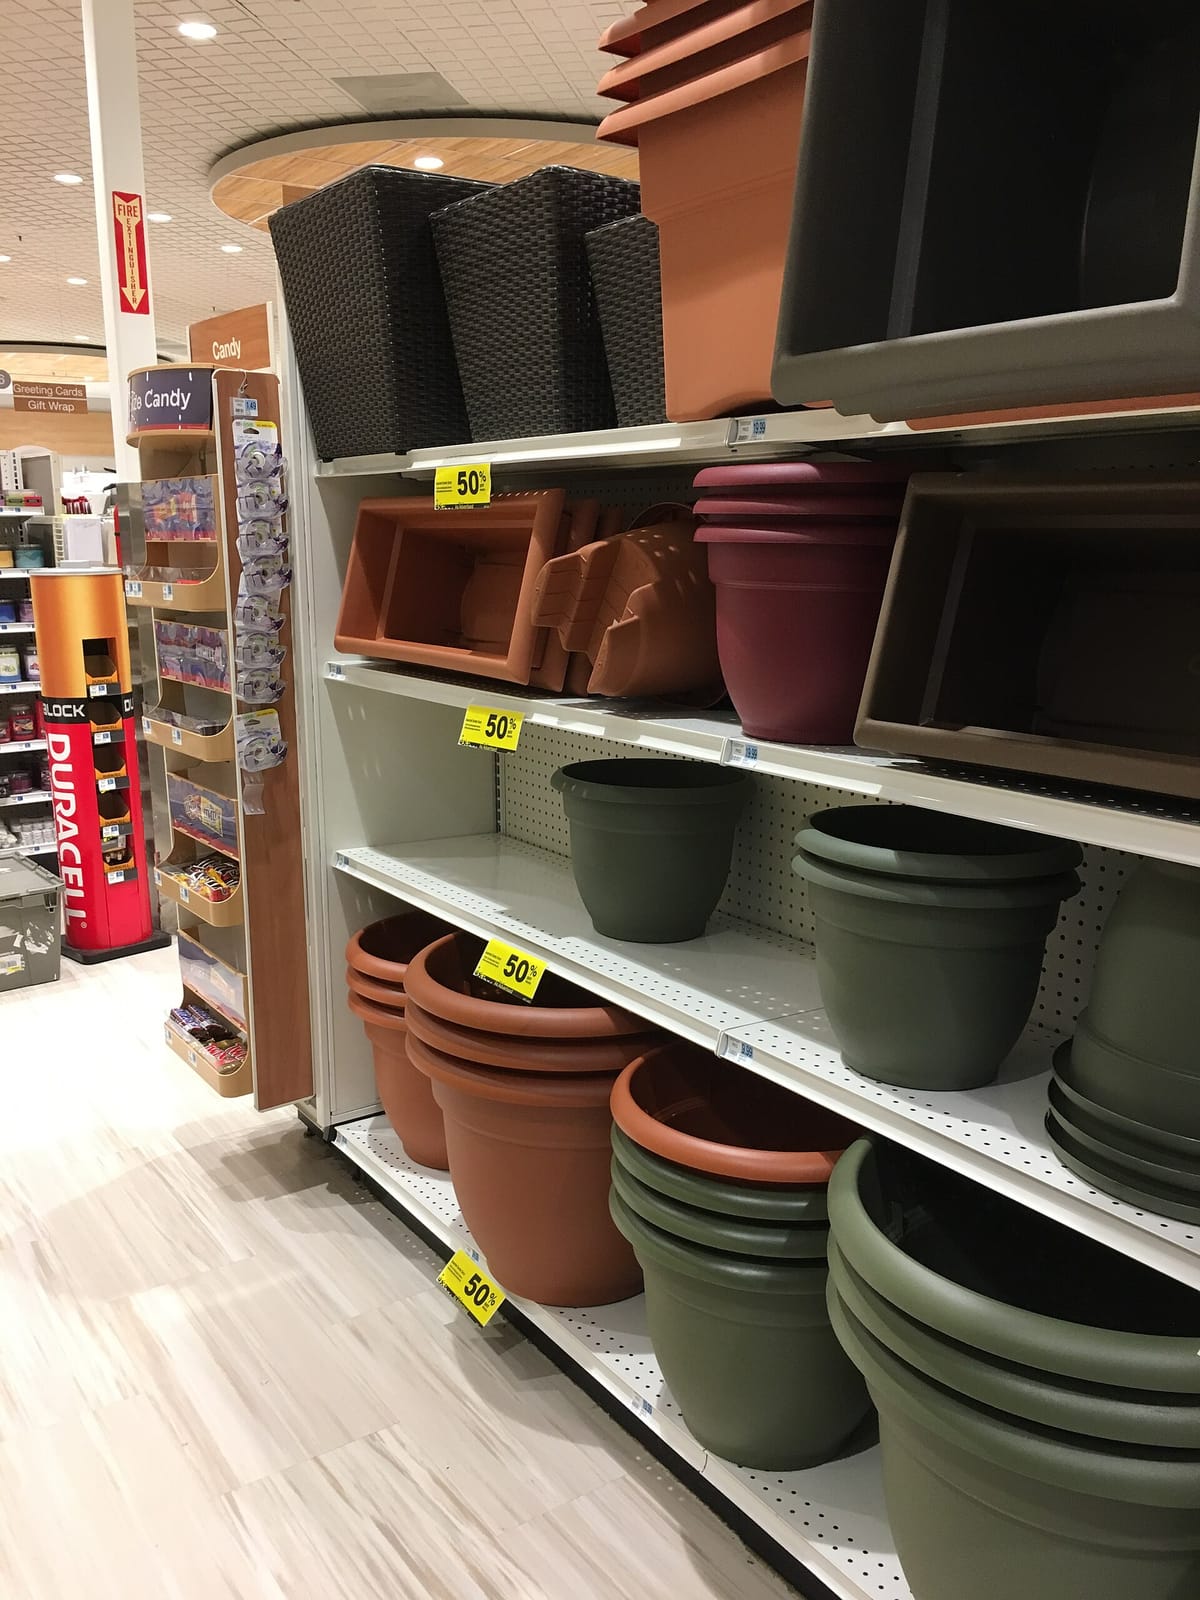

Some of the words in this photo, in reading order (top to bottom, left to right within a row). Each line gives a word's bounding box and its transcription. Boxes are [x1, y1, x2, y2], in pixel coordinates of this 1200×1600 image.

[117, 203, 139, 218] FIRE
[126, 217, 138, 305] EXTINGUISHER
[212, 337, 241, 360] Candy
[13, 383, 53, 397] Greeting
[55, 386, 83, 397] Cards
[144, 388, 191, 410] Candy
[28, 400, 46, 410] Gift
[48, 401, 75, 413] Wrap
[457, 470, 487, 496] 50%
[485, 713, 517, 740] 50%
[47, 732, 87, 926] DURACELL
[503, 953, 538, 983] 50%
[464, 1273, 498, 1307] 50%
